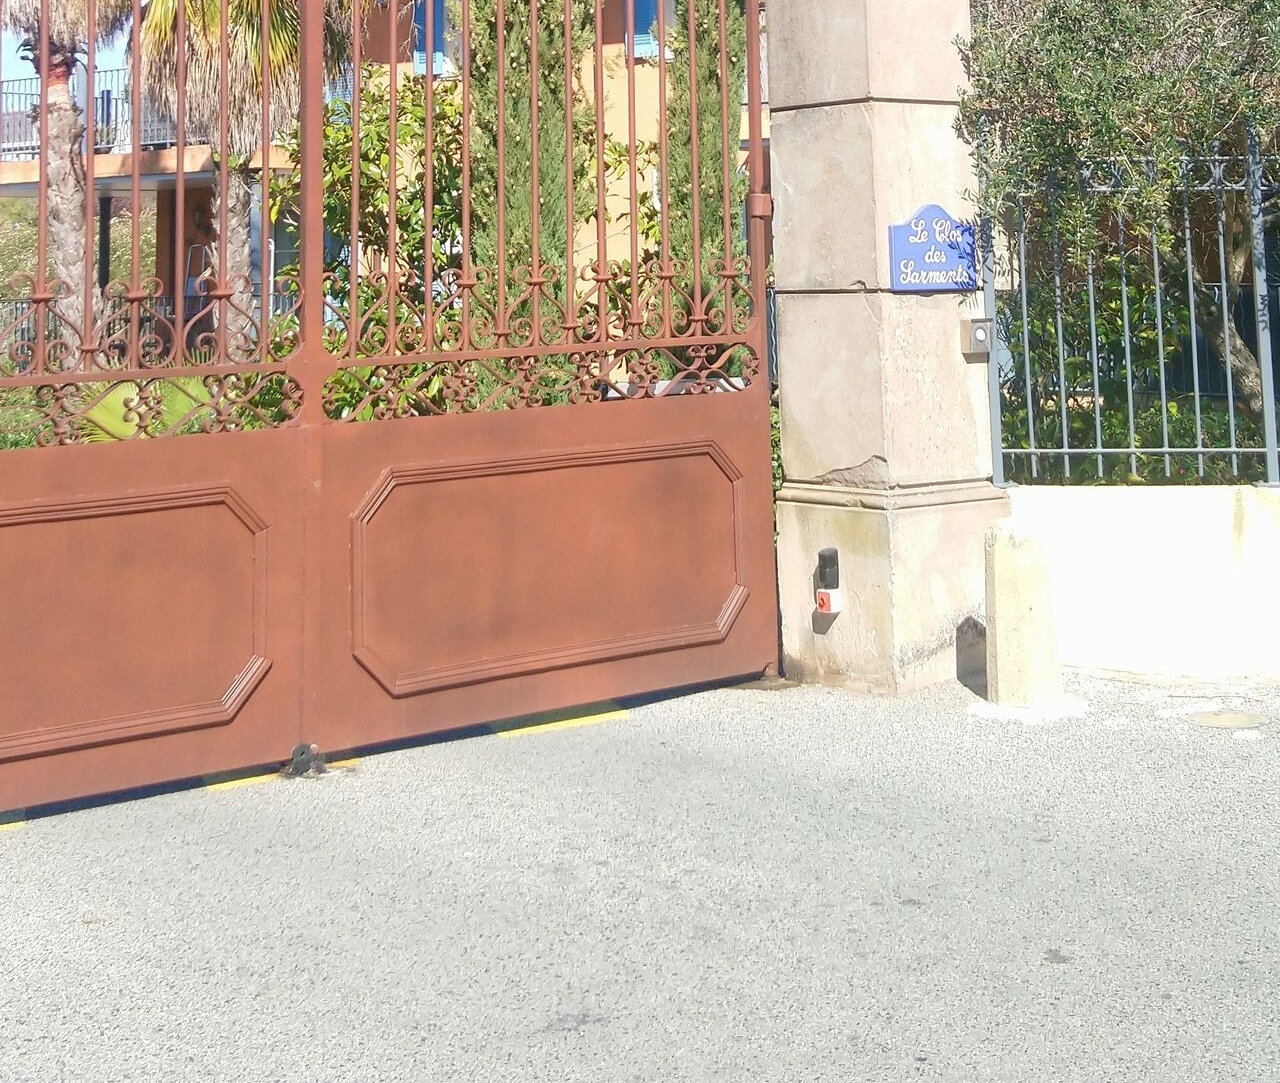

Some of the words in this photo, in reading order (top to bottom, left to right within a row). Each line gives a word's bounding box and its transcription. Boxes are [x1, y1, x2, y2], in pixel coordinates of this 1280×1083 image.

[908, 218, 929, 243] Le
[932, 217, 962, 244] Clos
[924, 245, 947, 263] des
[900, 259, 969, 284] Sarments
